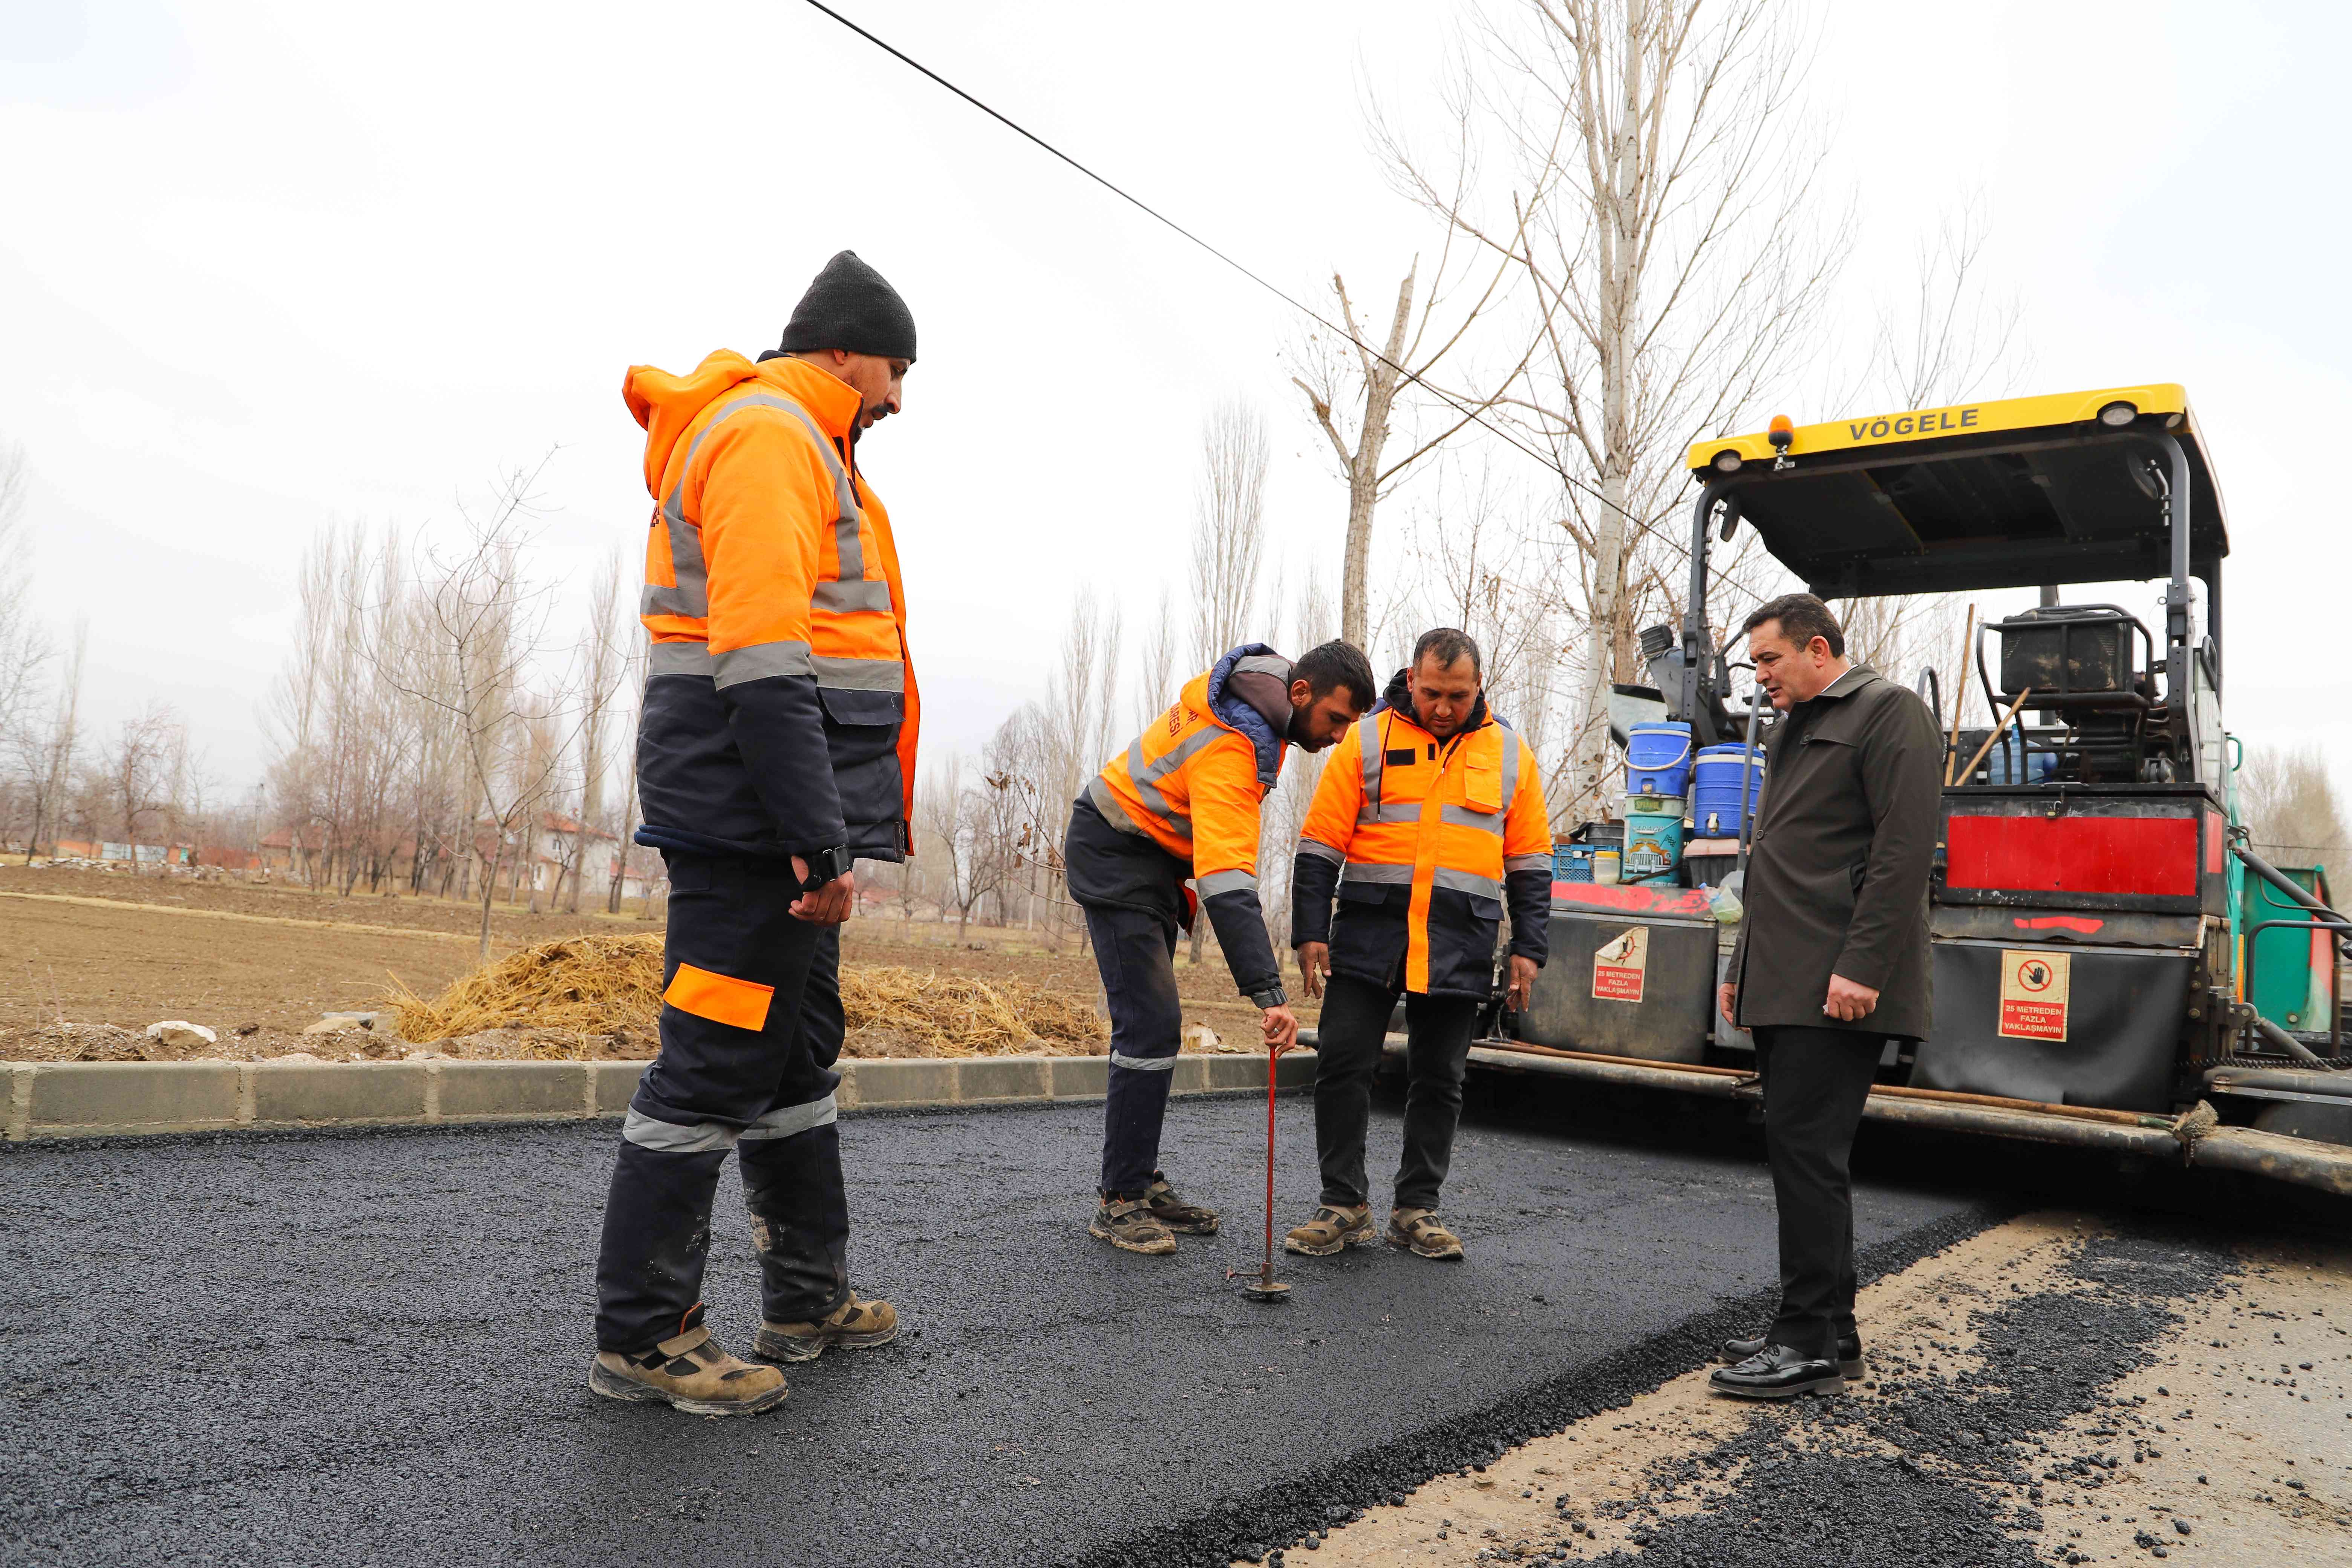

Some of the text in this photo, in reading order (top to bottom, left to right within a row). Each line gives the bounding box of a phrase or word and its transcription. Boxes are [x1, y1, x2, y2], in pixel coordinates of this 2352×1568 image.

[1850, 408, 1979, 440] VÖGELE
[1597, 986, 1640, 995] YAKLAŞMAYIN
[2017, 1006, 2062, 1015] METREDEN
[2020, 1015, 2046, 1023] FAZLA
[2004, 1023, 2061, 1033] YAKLAŞMAYIN
